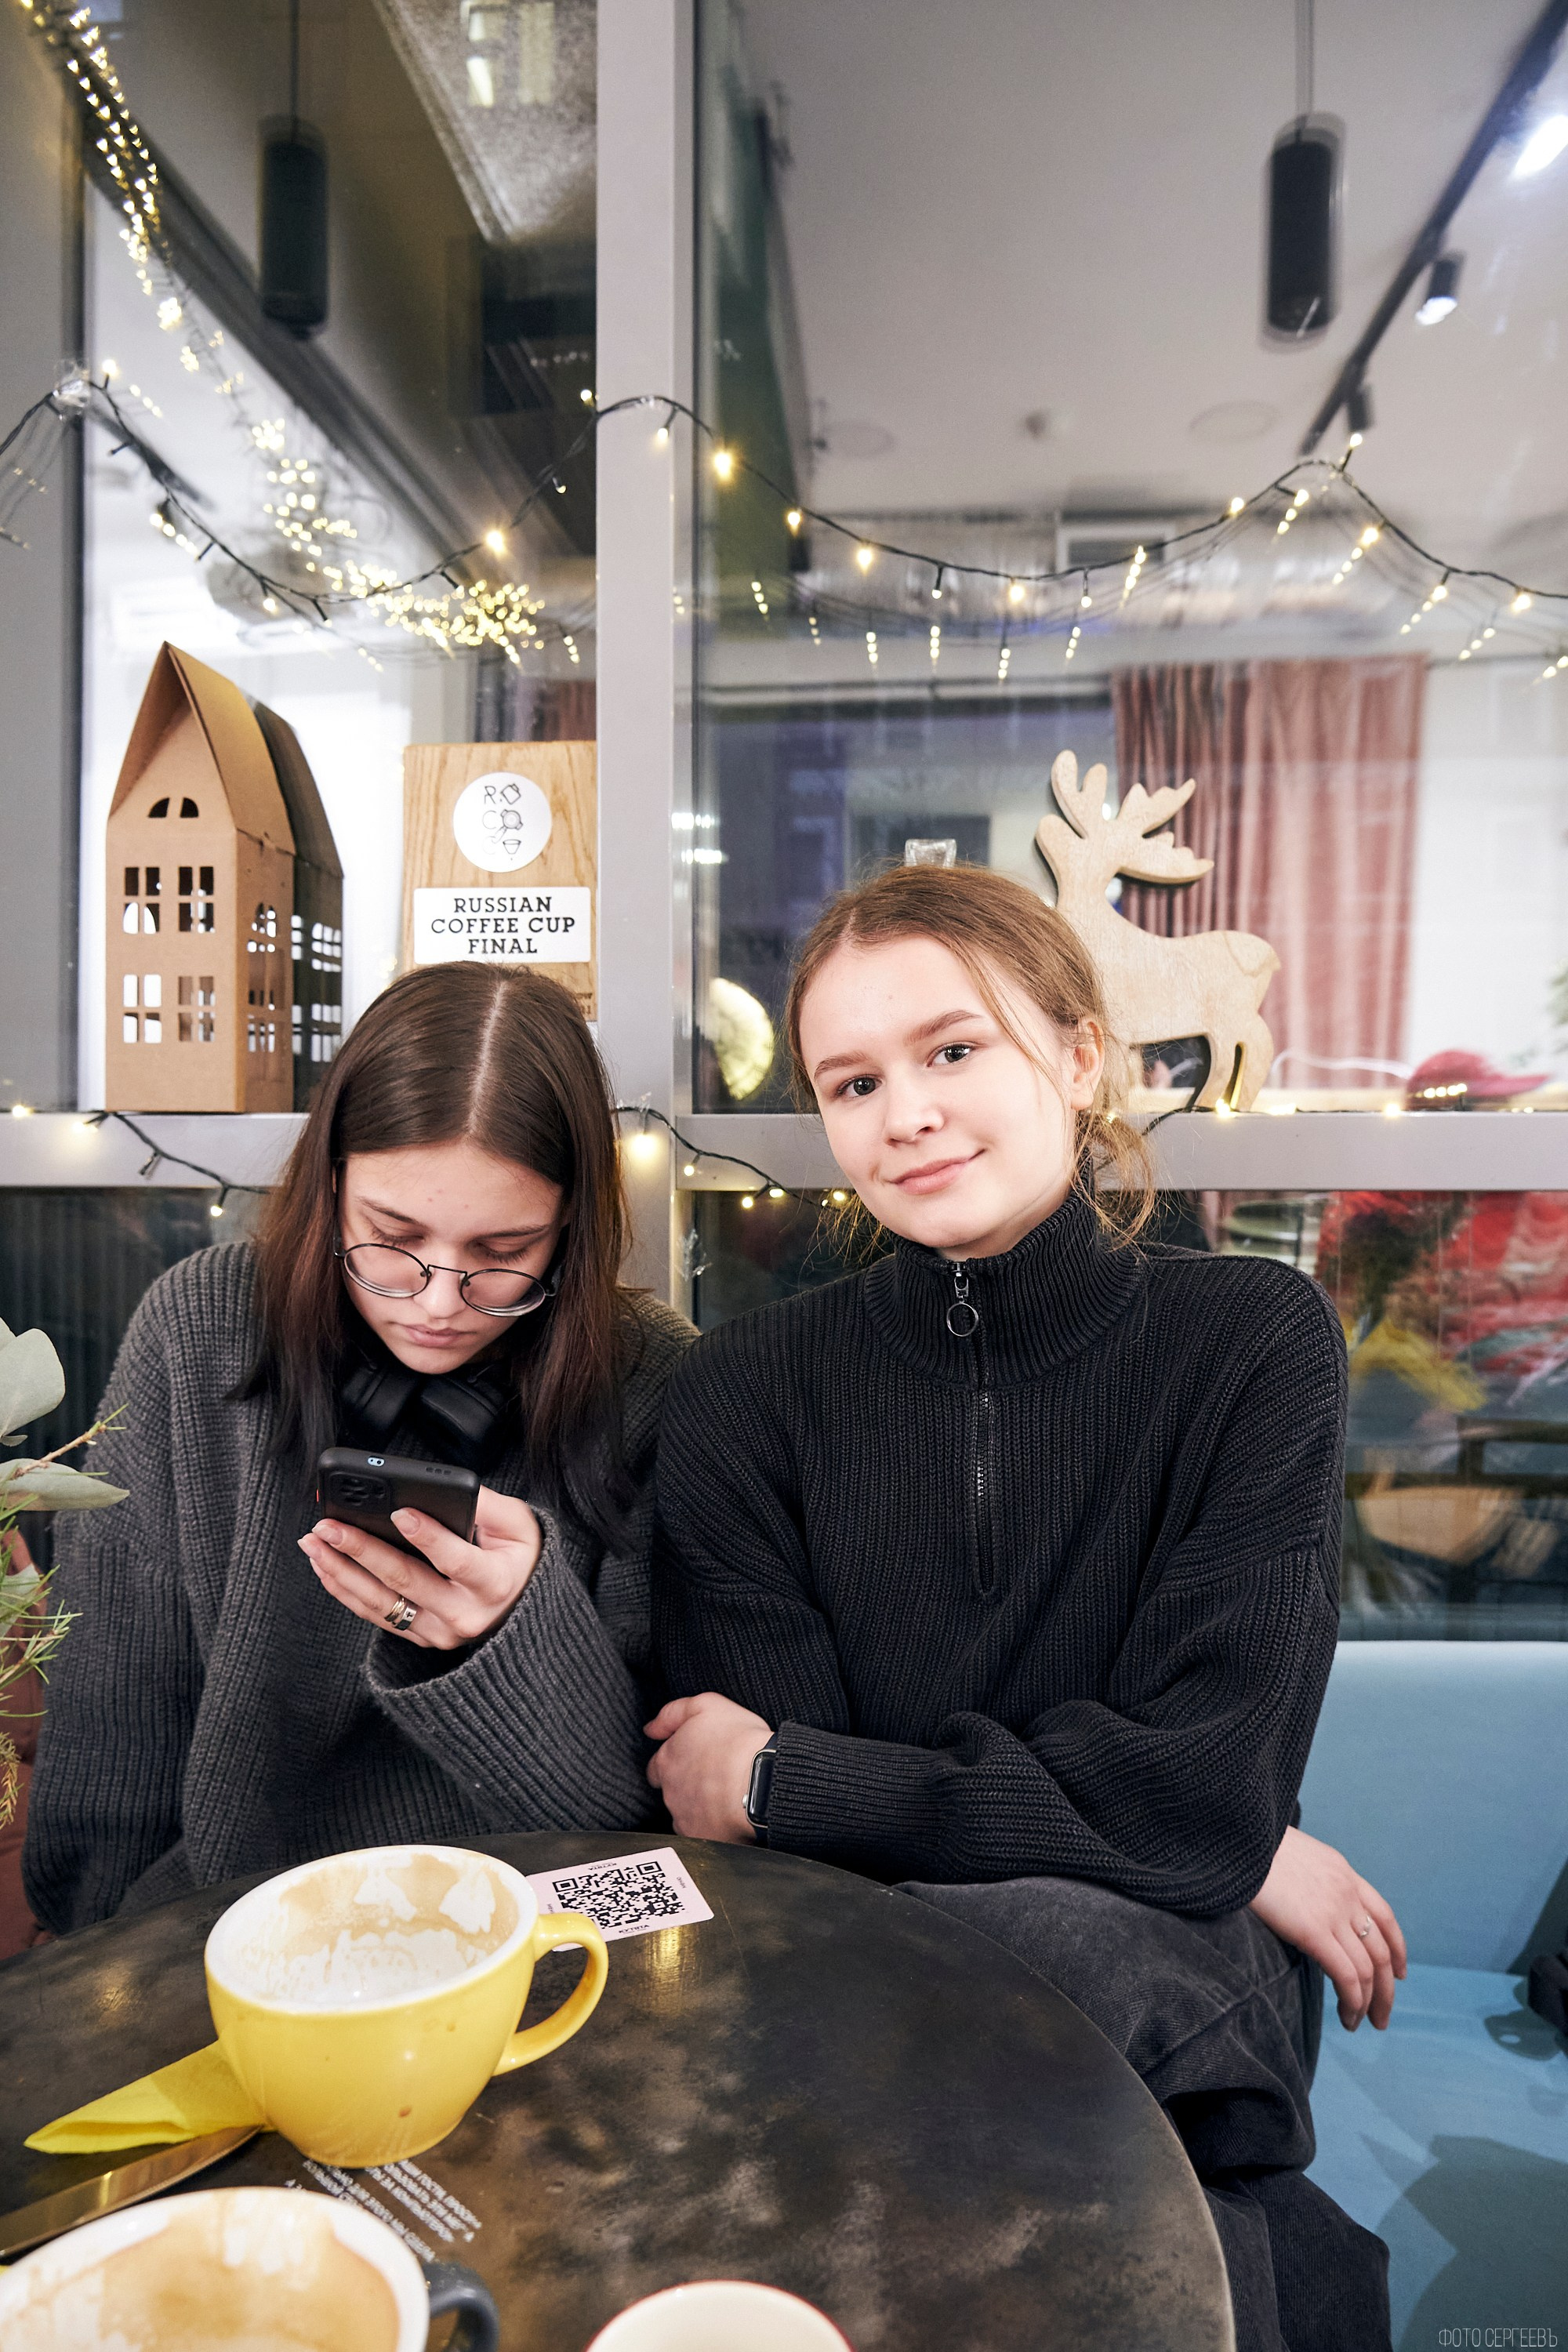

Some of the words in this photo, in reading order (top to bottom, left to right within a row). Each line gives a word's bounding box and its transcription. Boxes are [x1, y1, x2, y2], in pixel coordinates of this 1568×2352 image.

[454, 896, 552, 913] RUSSIAN
[431, 917, 518, 934] COFFEE
[528, 916, 575, 933] CUP
[468, 938, 538, 954] FINAL
